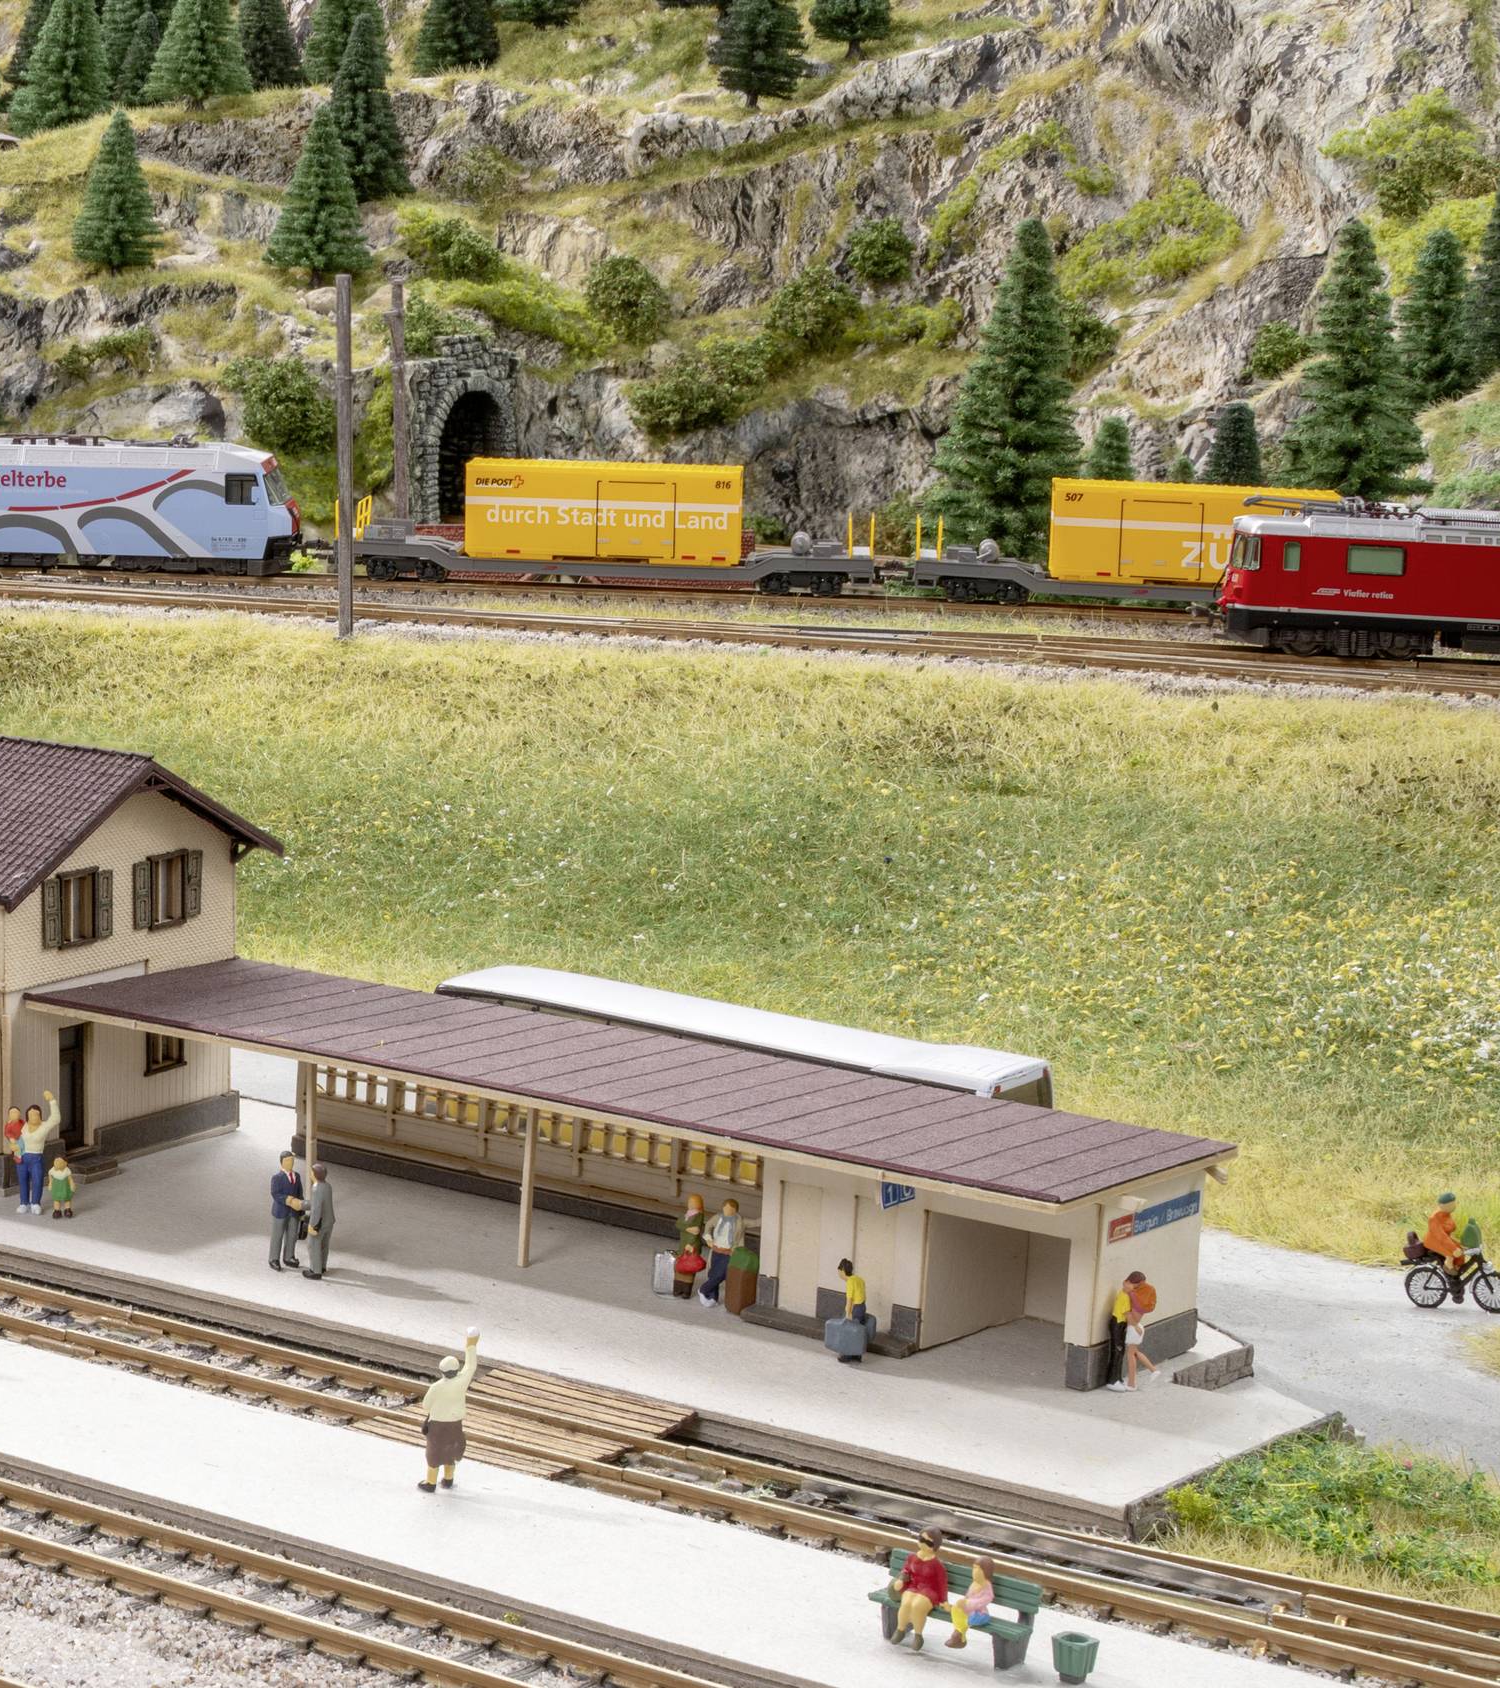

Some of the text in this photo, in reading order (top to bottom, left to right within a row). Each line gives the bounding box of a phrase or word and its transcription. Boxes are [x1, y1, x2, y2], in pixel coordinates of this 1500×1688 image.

[476, 477, 513, 487] DIE POST
[715, 480, 732, 490] 816
[1065, 492, 1084, 502] 507
[486, 504, 728, 530] durch Stadt und Land
